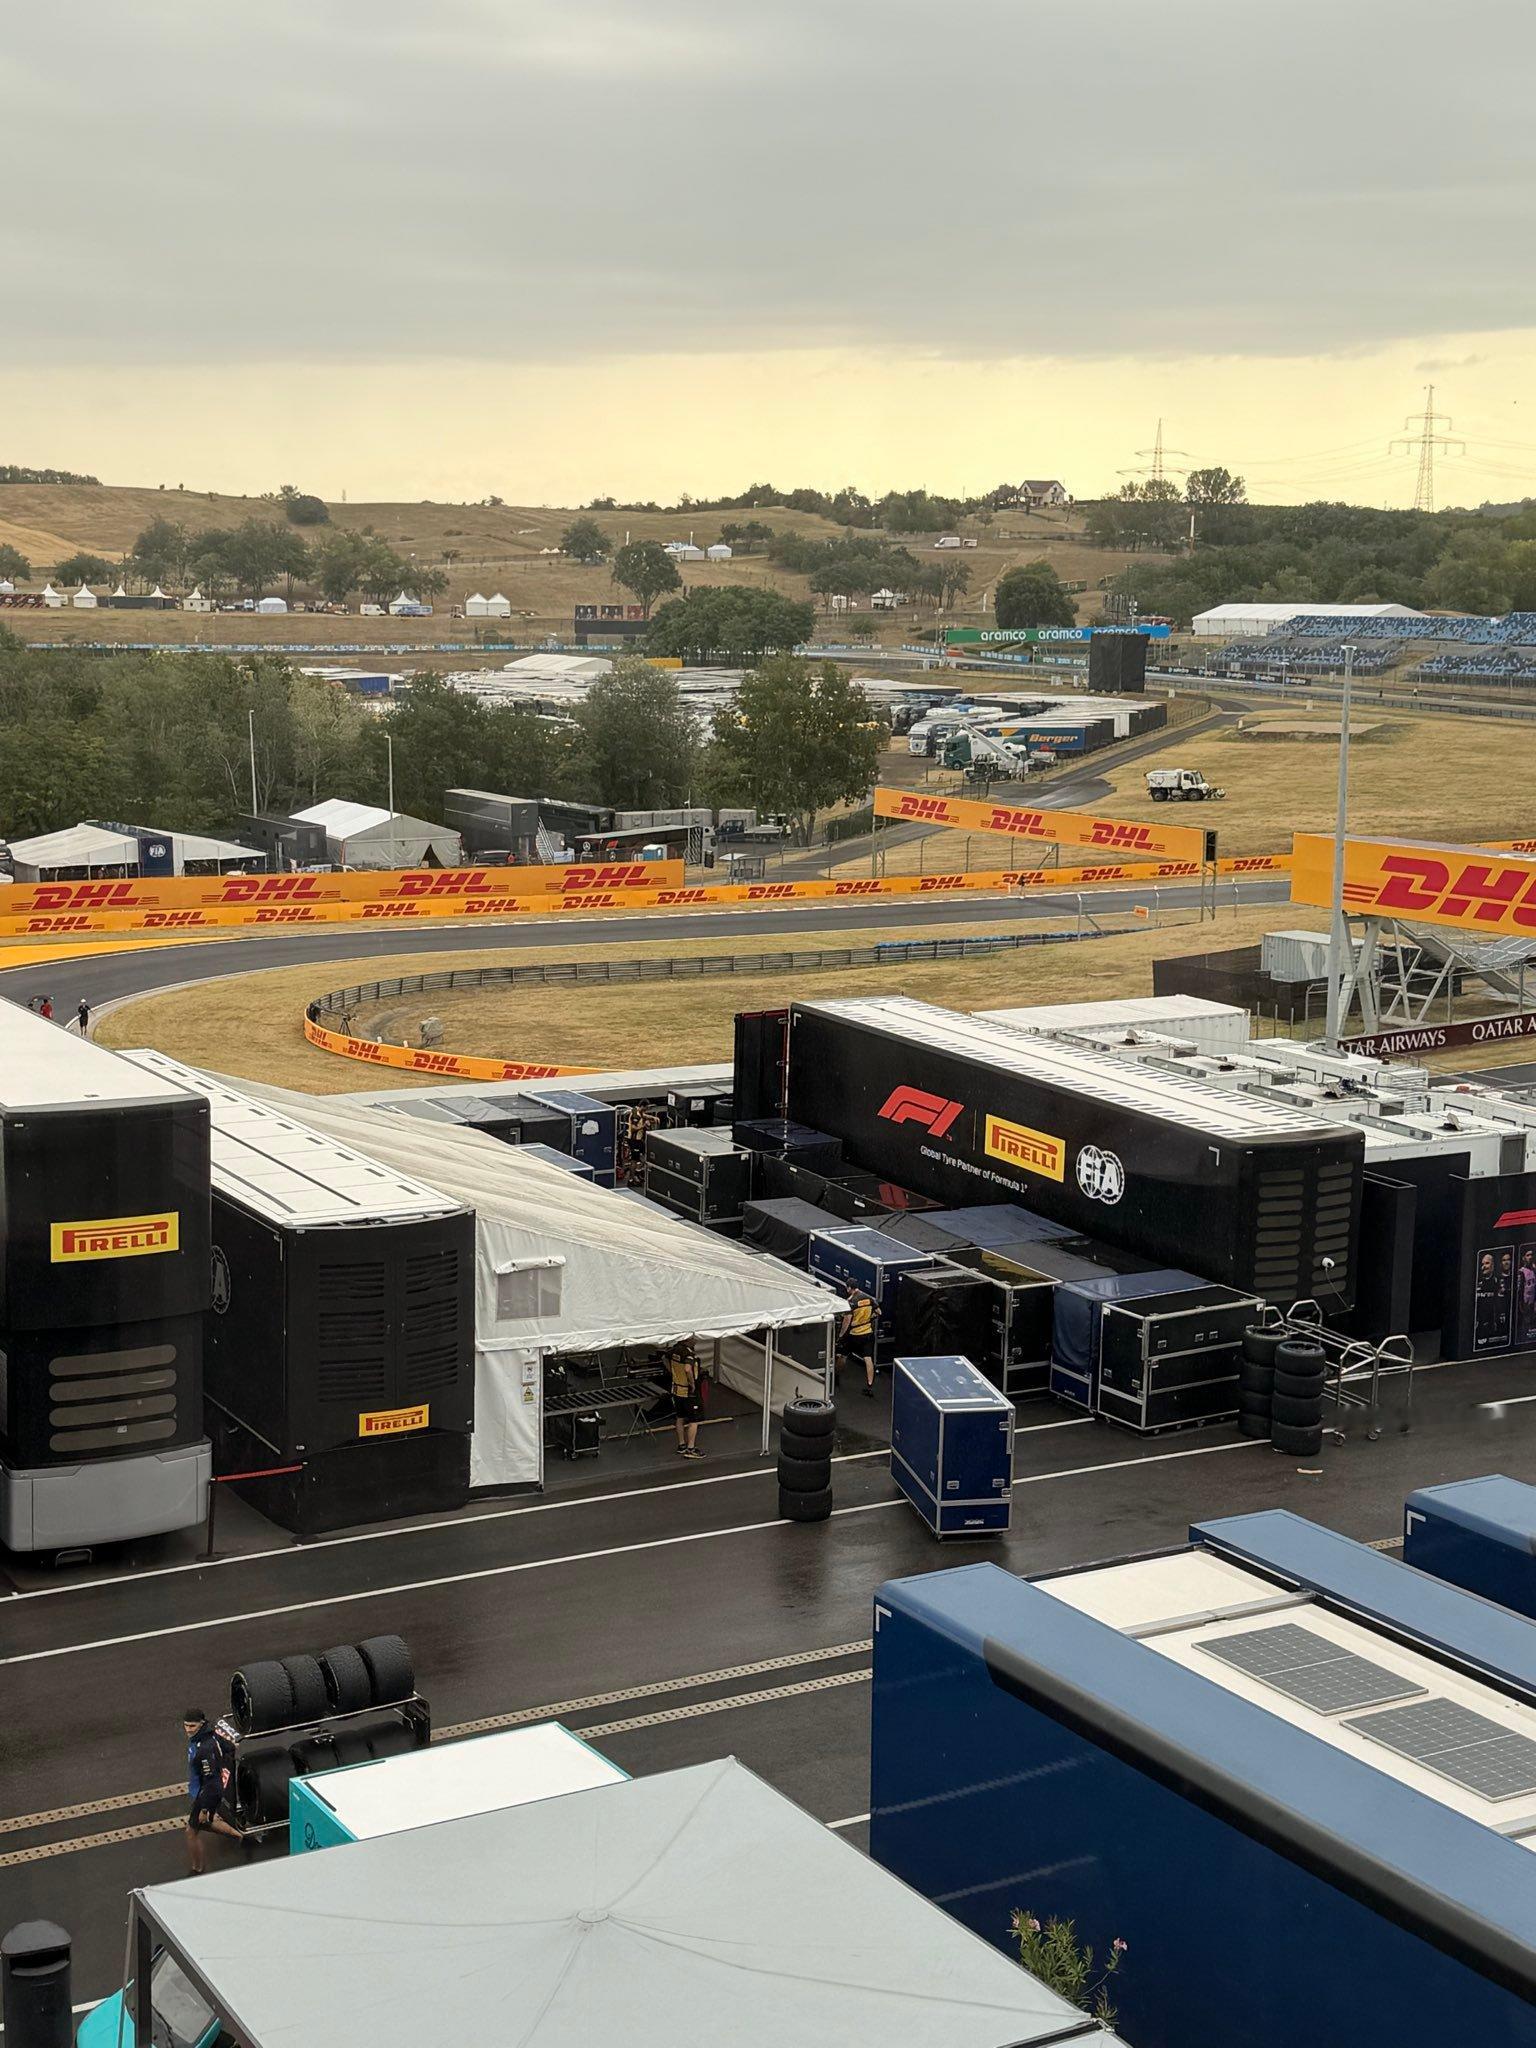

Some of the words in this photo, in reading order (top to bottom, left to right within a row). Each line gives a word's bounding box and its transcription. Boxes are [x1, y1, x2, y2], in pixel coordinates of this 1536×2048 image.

[981, 630, 1026, 641] aramco
[1038, 629, 1083, 640] aramco
[1029, 733, 1078, 744] Berger
[899, 796, 952, 820] DHL
[990, 809, 1048, 837] DHL
[1091, 823, 1154, 851] DHL
[1081, 867, 1126, 882] DHL
[1158, 863, 1200, 876] DHL
[1233, 859, 1273, 872] DHL
[398, 873, 493, 897] DHL
[562, 866, 653, 891] DHL
[835, 881, 884, 895] DHL
[920, 876, 966, 891] DHL
[32, 883, 141, 910] DHL
[221, 877, 324, 902] DHL
[656, 889, 708, 904] DHL
[748, 884, 798, 899] DHL
[361, 903, 421, 918] DHL
[464, 899, 520, 914] DHL
[562, 894, 617, 910] DHL
[27, 916, 93, 933] DHL
[143, 911, 207, 927] DHL
[255, 907, 316, 923] DHL
[1472, 1017, 1524, 1041] QATAR
[348, 1039, 382, 1060] DHL
[1379, 1030, 1446, 1053] AIRWAYS
[413, 1052, 462, 1074] DHL
[877, 1085, 965, 1138] F1
[991, 1124, 1059, 1171] PIRELLI
[920, 1145, 941, 1160] Global
[942, 1153, 956, 1167] Tyre
[957, 1159, 982, 1176] Partner
[982, 1170, 990, 1179] of
[991, 1172, 1020, 1191] Formula
[62, 1221, 169, 1253] PIRELLI
[365, 1410, 424, 1431] PIRELLI
